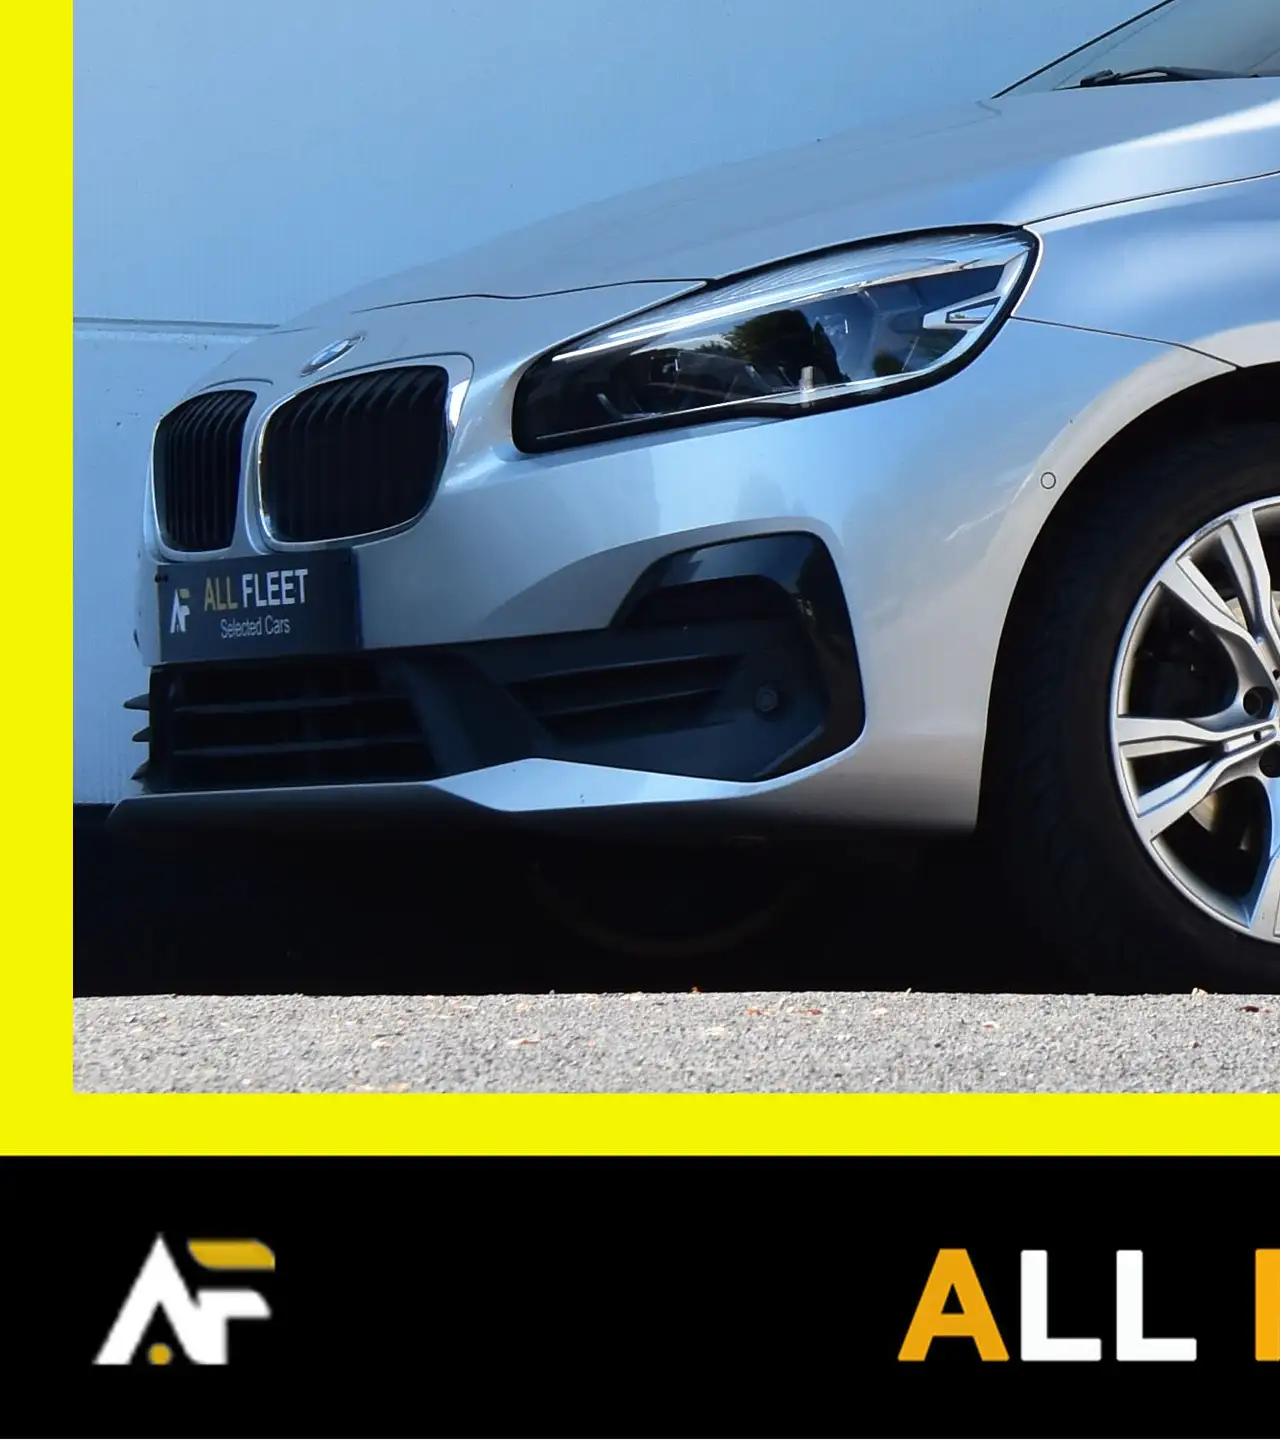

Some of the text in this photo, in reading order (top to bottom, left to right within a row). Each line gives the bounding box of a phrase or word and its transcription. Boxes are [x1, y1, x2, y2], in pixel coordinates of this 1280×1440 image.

[204, 568, 308, 611] ALL FLEET
[221, 615, 291, 639] Selected Cars
